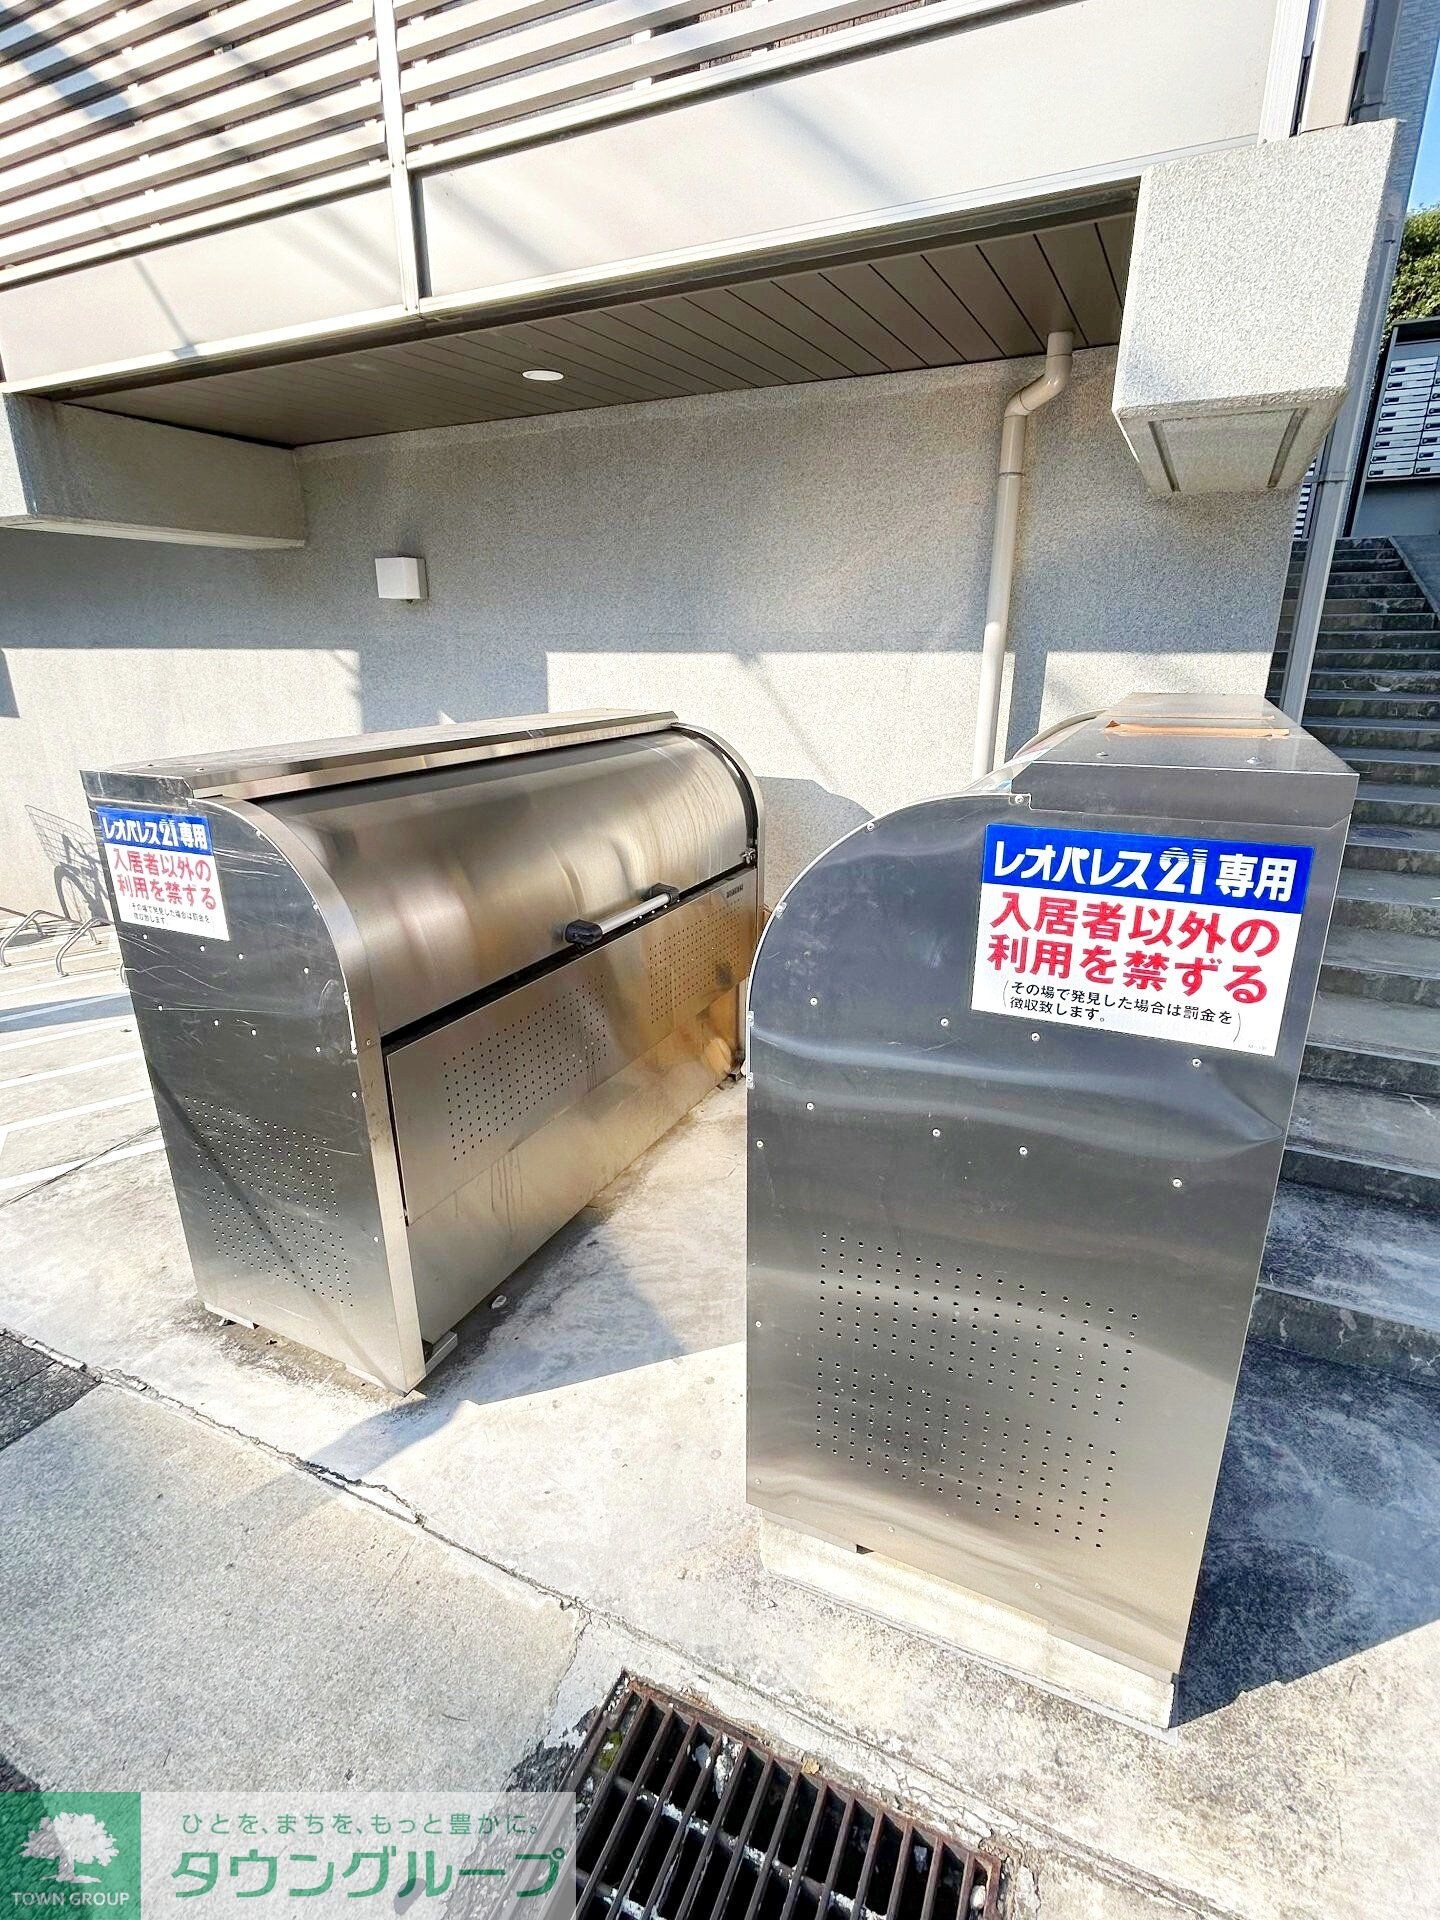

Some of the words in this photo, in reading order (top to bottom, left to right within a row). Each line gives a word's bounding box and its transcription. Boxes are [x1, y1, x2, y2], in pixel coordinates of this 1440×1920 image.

[113, 848, 212, 882] 入居者以外の
[990, 891, 1280, 958] 入居者以外の
[987, 933, 1269, 1005] 利用を禁ずる
